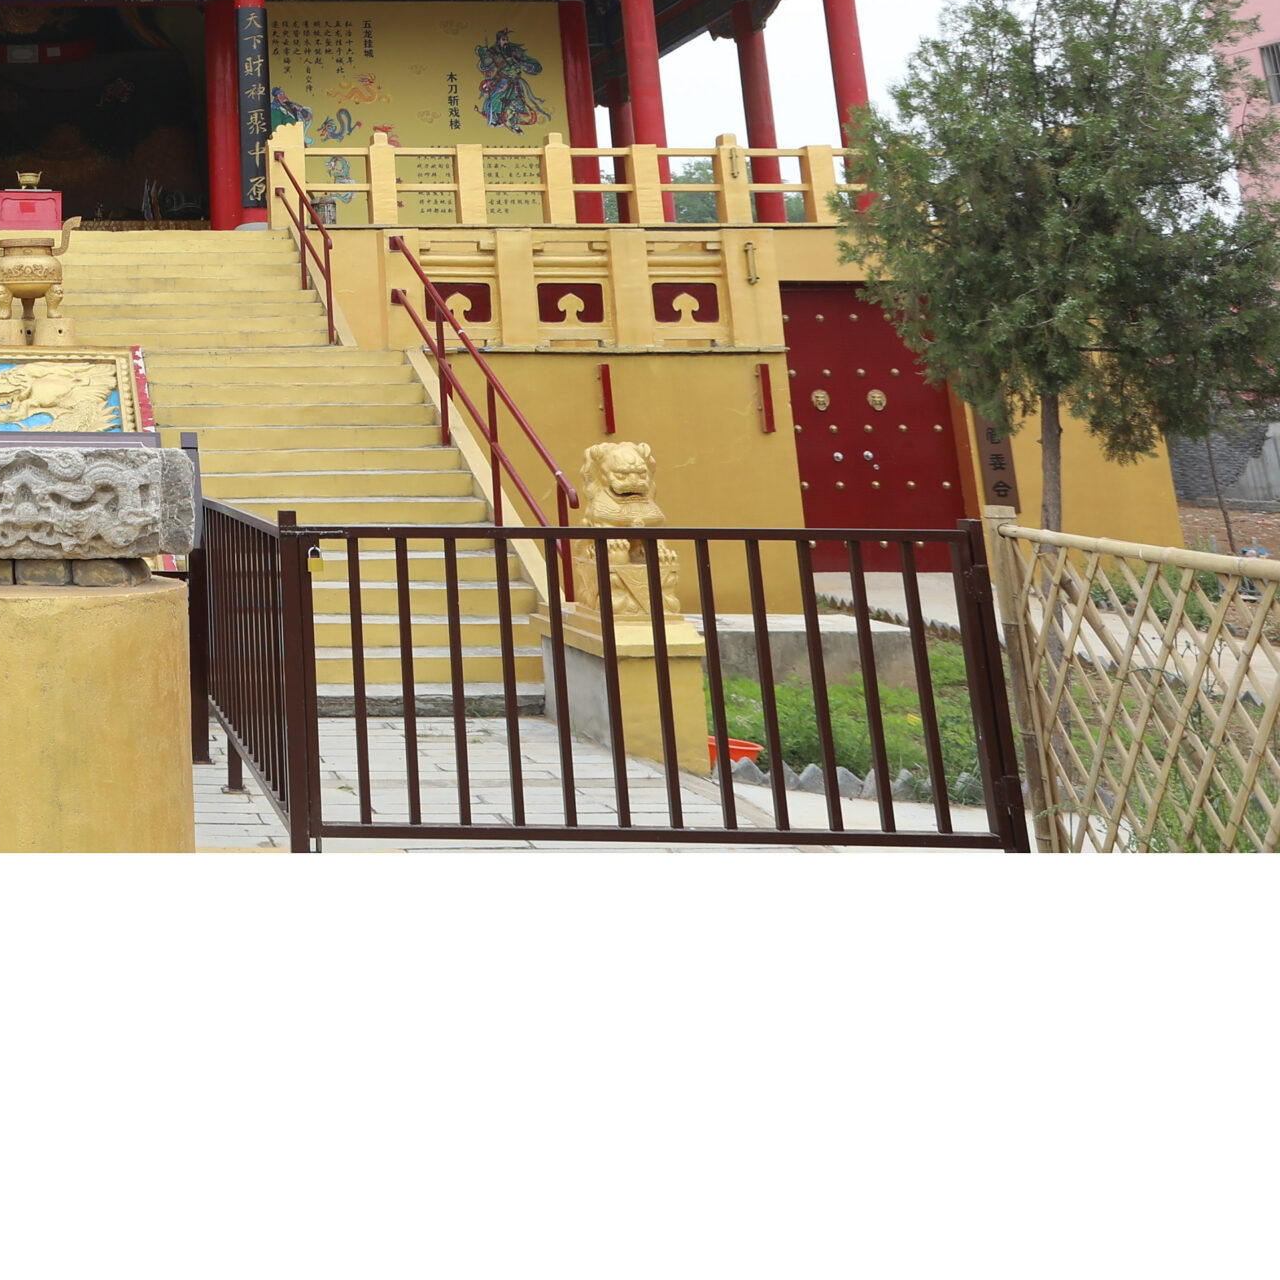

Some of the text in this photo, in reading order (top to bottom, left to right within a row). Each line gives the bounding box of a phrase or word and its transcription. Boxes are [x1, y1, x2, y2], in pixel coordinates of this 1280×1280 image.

[446, 72, 461, 131] 木刀斩戏楼
